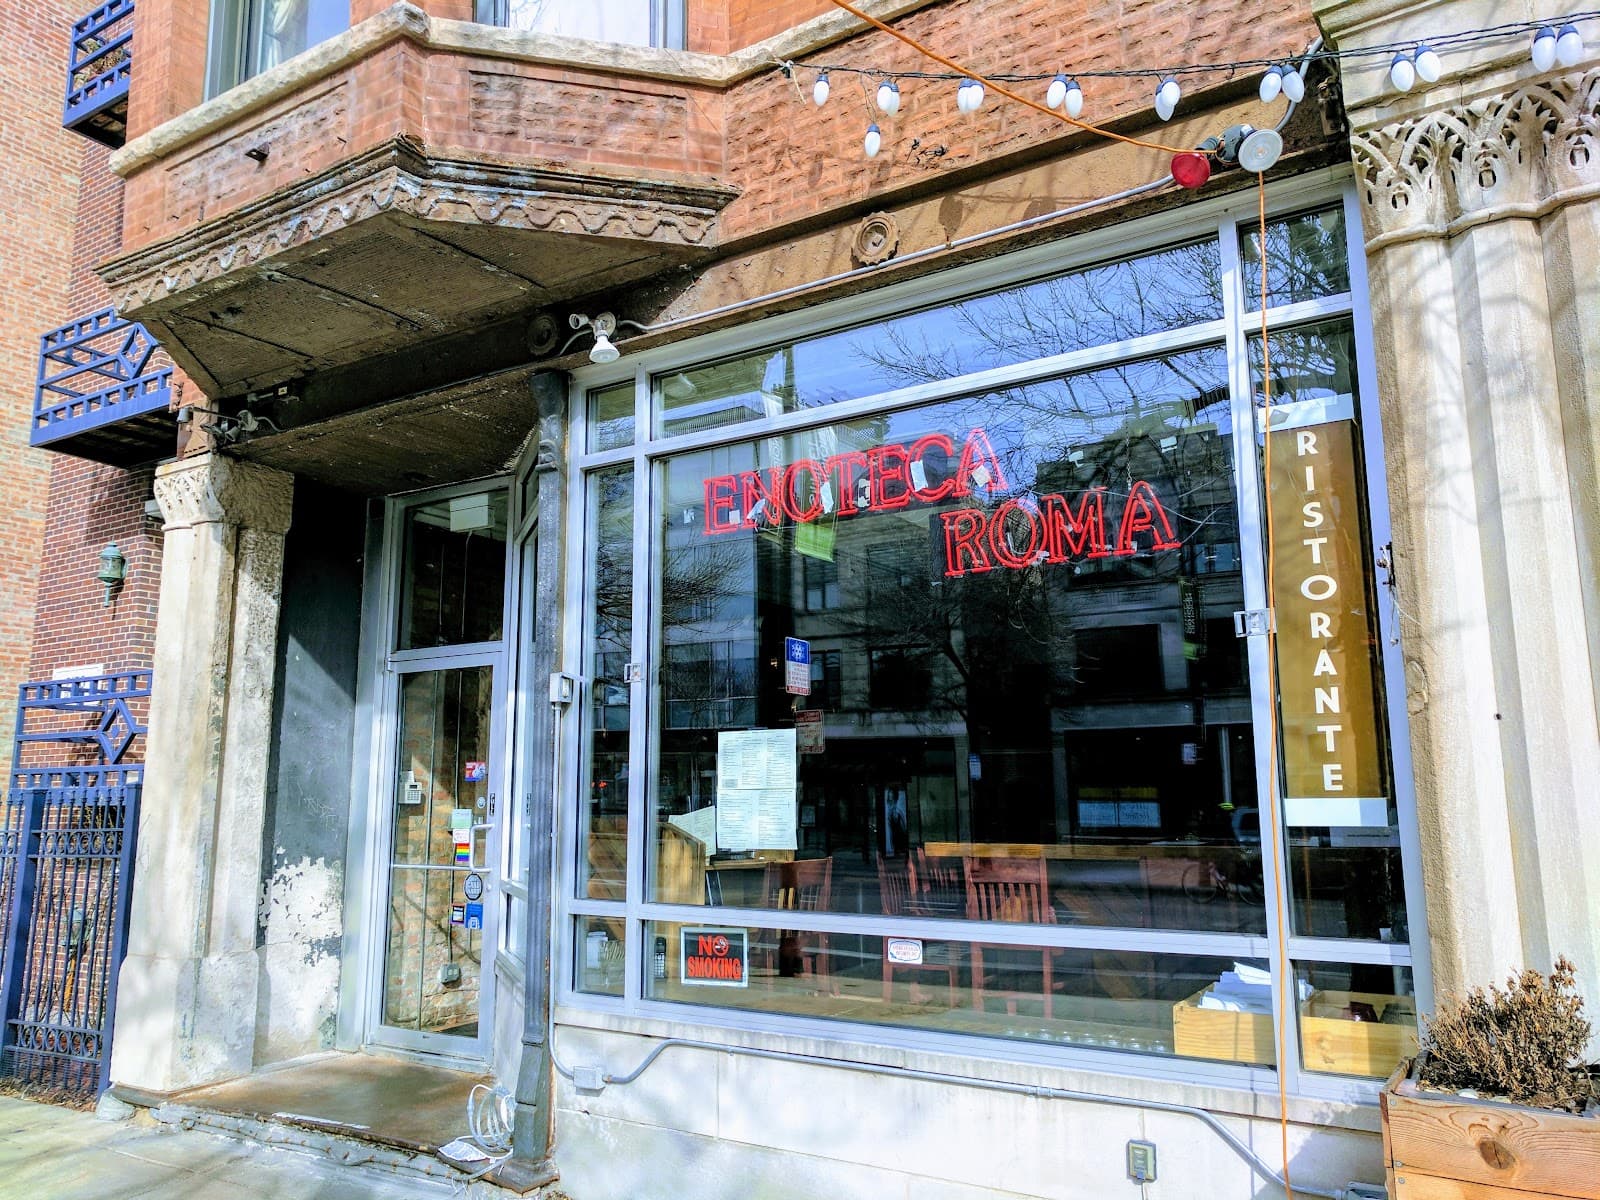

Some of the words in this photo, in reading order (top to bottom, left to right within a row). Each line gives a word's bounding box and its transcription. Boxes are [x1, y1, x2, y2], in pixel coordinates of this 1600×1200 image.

[703, 428, 1008, 536] ENOTECA
[940, 480, 1182, 577] ROMA
[1296, 430, 1343, 792] RISTORANTE
[687, 955, 742, 981] SMOKING
[698, 934, 729, 957] NO
